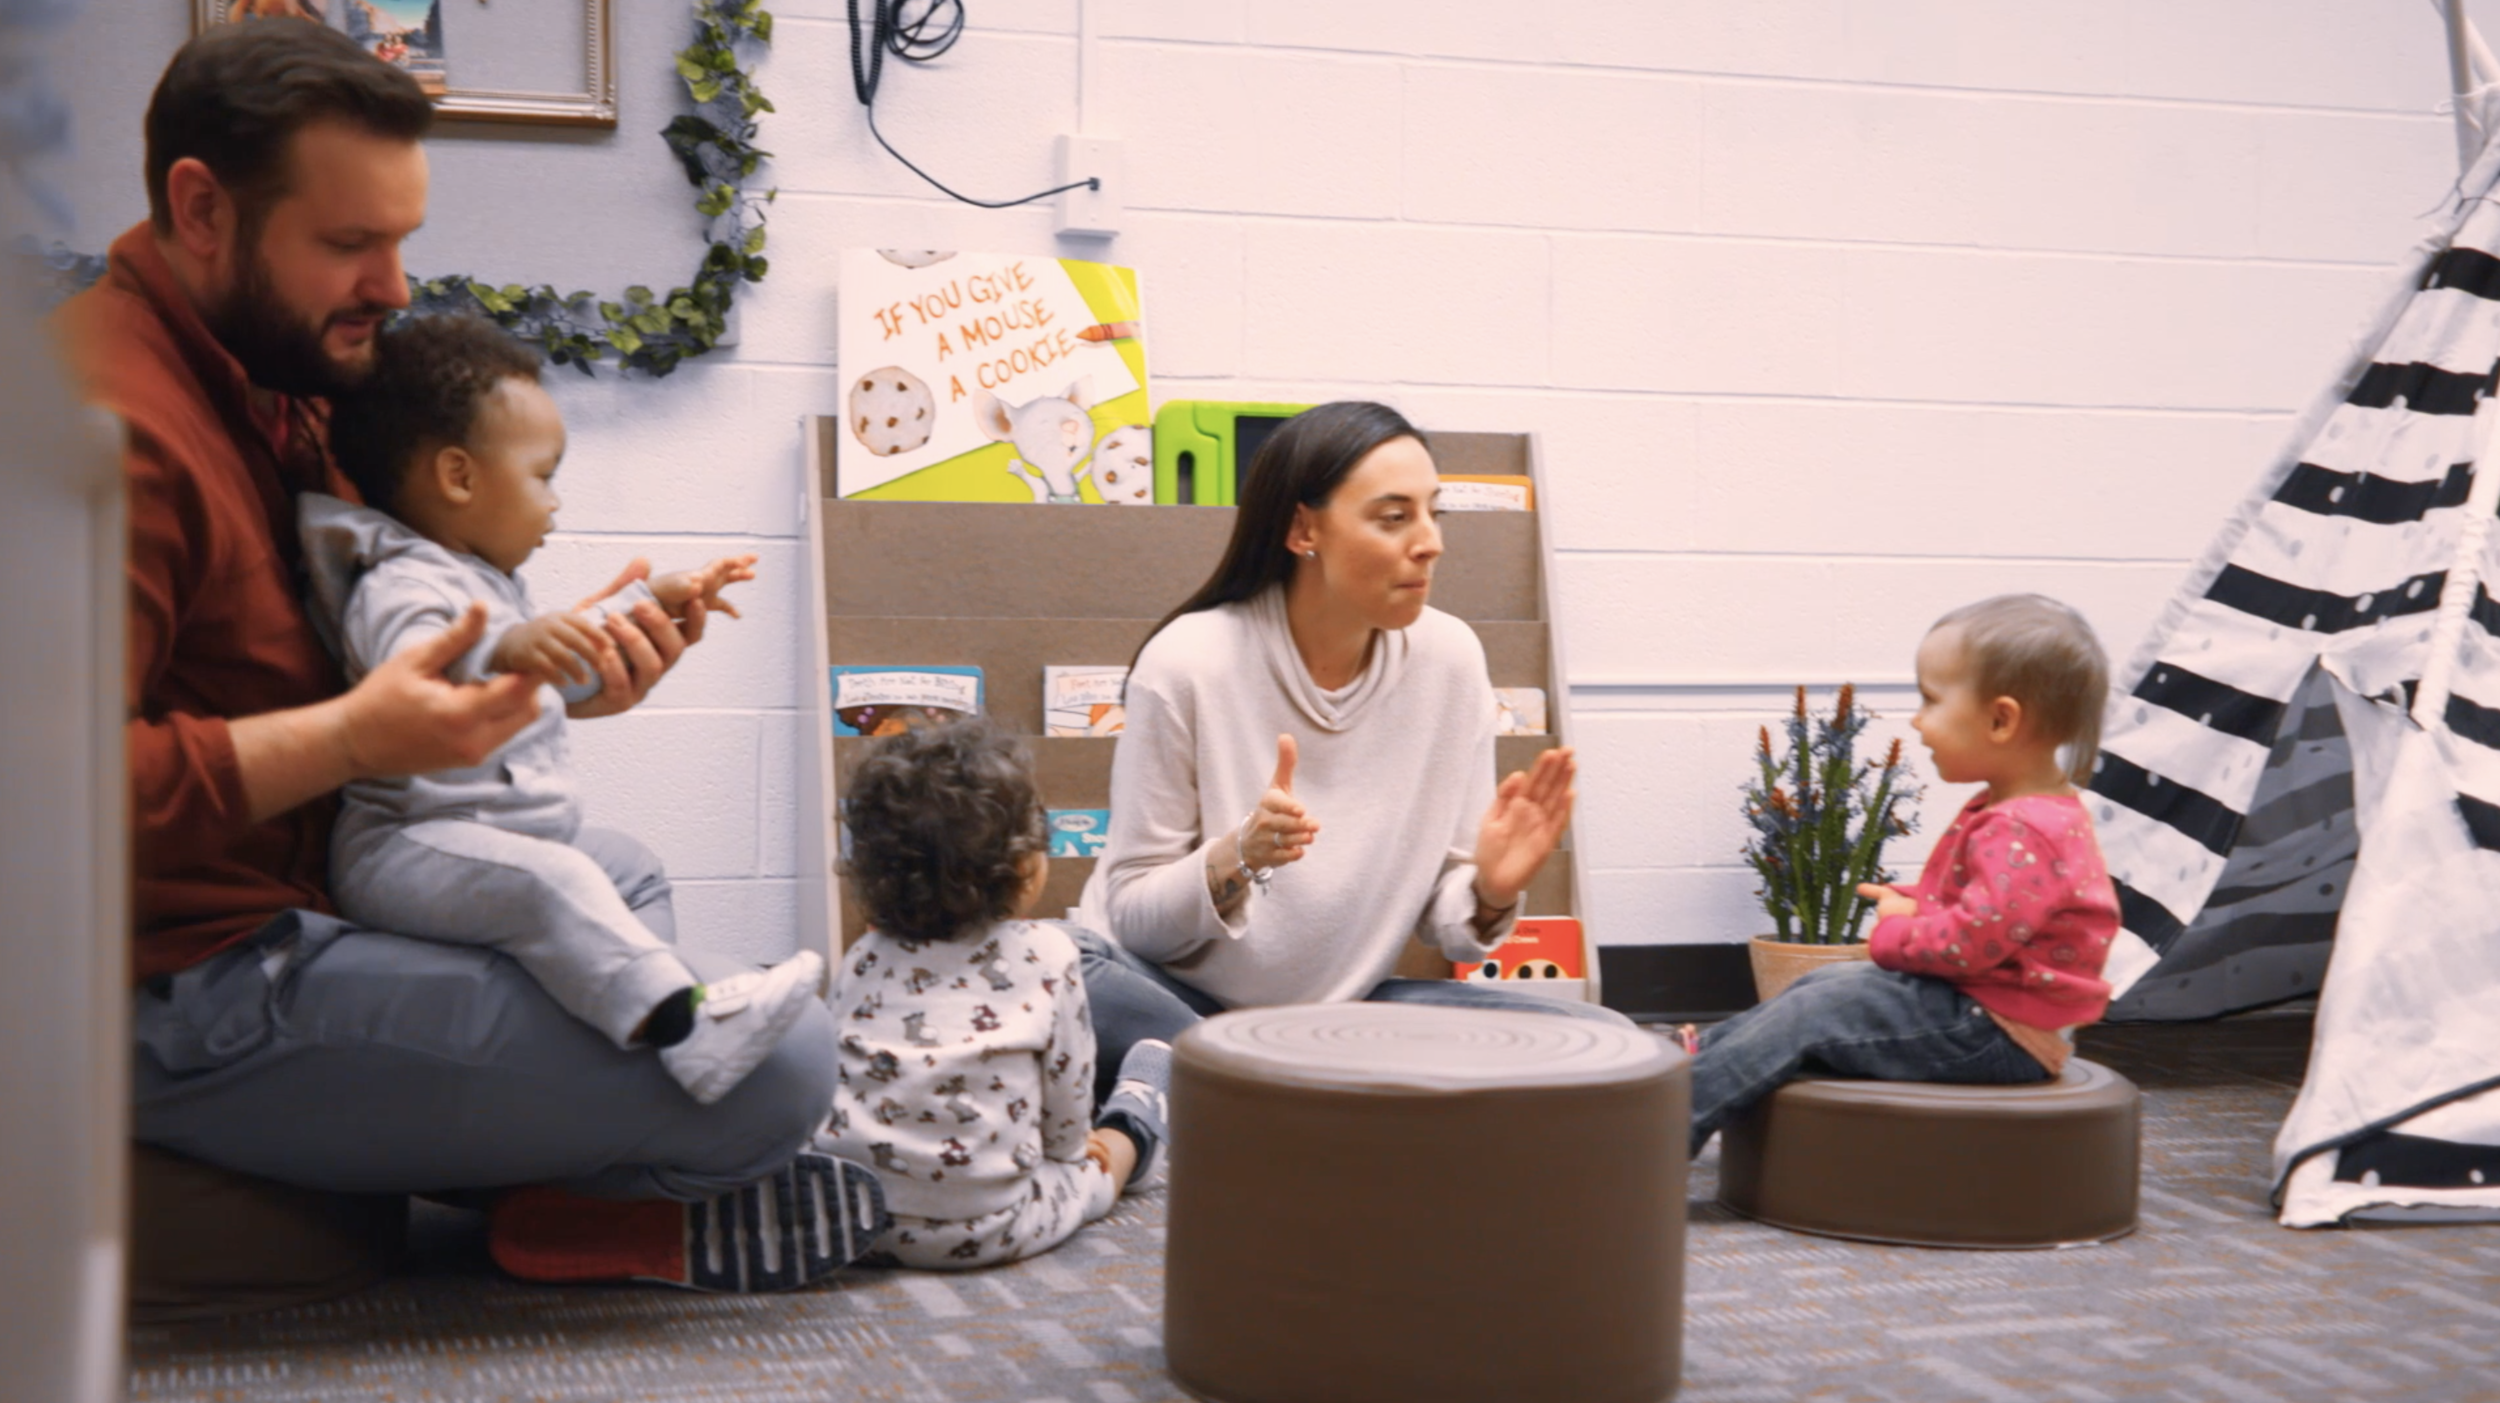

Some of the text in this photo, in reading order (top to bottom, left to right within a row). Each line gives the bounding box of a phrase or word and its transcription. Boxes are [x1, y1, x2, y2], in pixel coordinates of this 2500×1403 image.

[874, 262, 1034, 341] IF YOU GIVE
[938, 298, 1055, 362] A MOUSE
[951, 328, 1076, 402] A COOKIE
